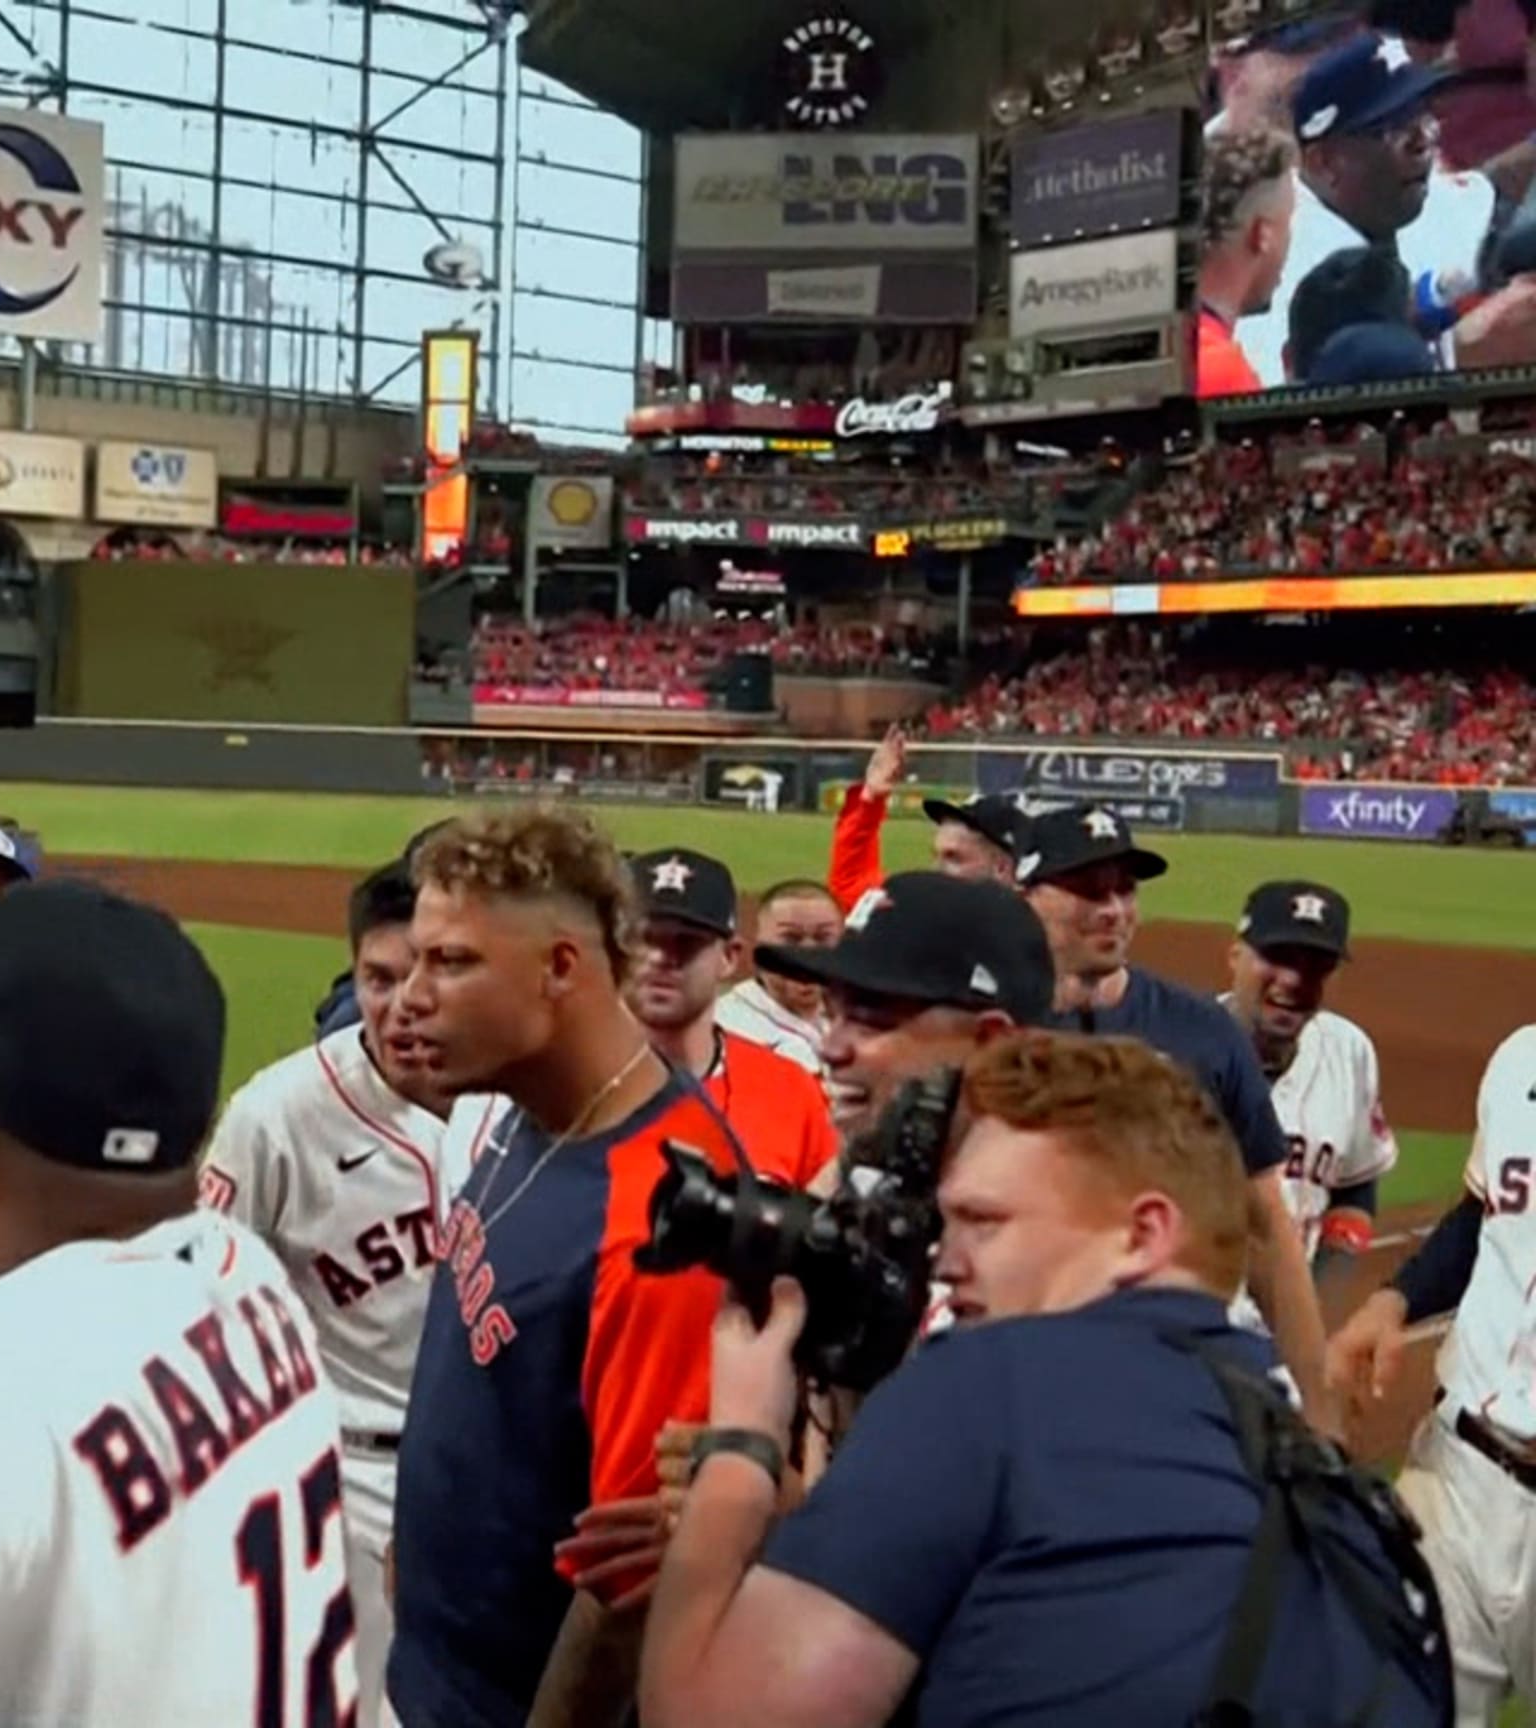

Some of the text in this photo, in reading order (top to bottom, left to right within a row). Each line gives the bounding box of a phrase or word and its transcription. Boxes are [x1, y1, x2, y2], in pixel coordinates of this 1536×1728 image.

[808, 54, 847, 90] H
[783, 153, 968, 225] LNG
[646, 520, 737, 541] impact
[768, 523, 860, 544] impact
[1330, 791, 1427, 830] xfinity
